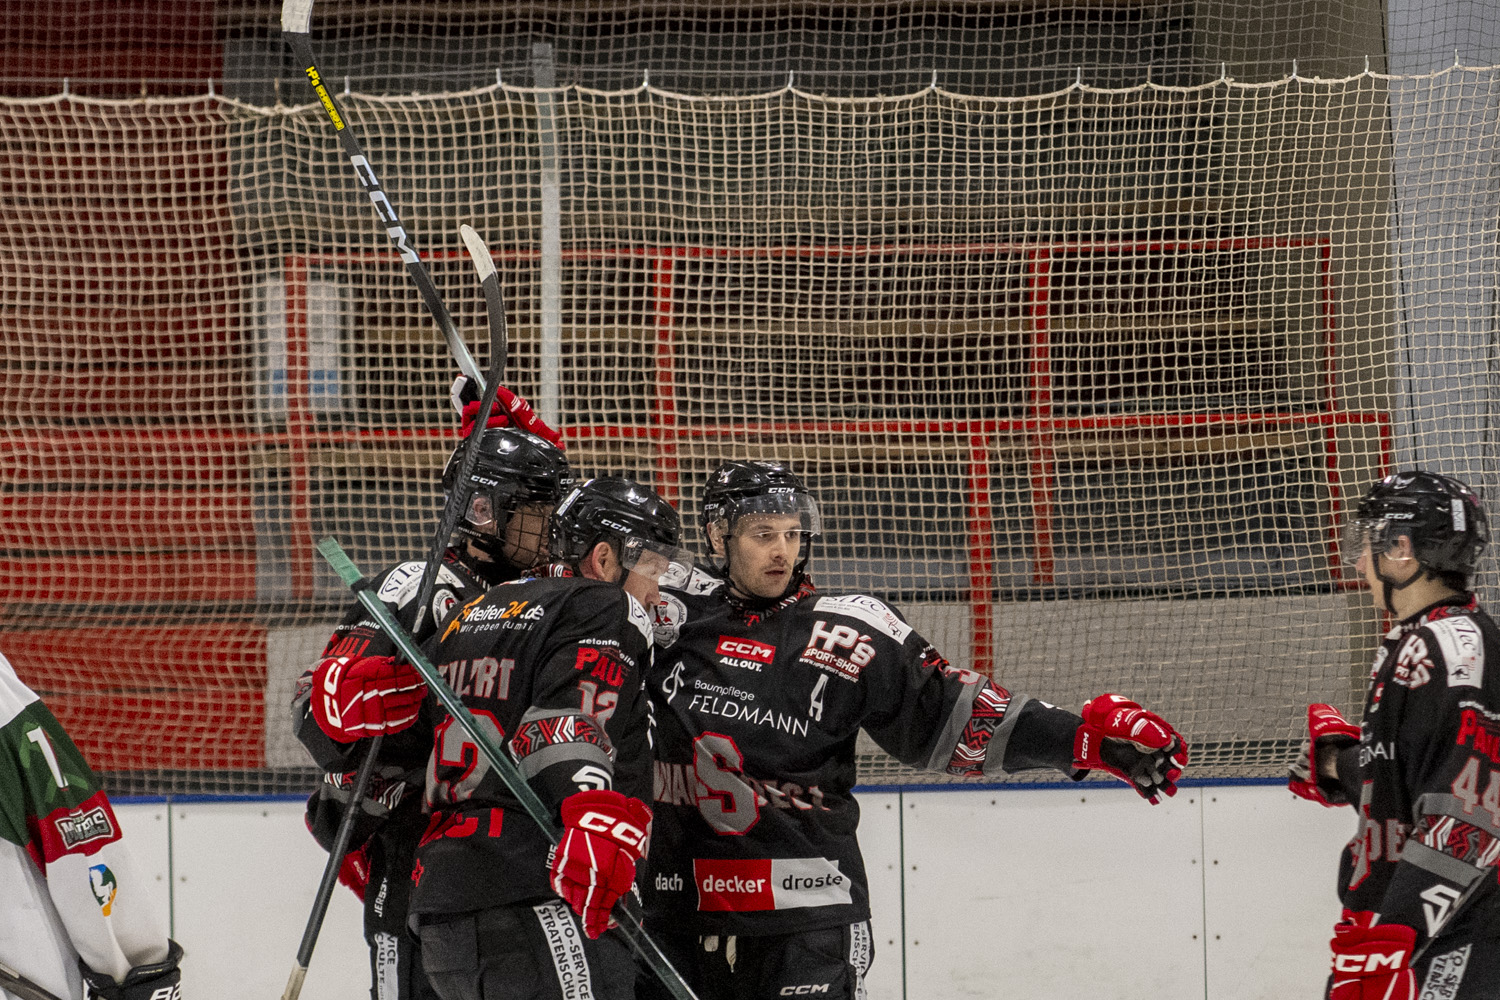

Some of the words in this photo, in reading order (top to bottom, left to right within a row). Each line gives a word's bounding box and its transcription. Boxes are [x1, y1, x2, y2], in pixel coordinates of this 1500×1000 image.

[350, 155, 419, 264] CCM
[470, 474, 499, 487] CCM
[767, 486, 795, 494] CCM
[1384, 512, 1415, 520] CCM
[600, 518, 632, 535] CCM
[465, 600, 545, 623] Reifen24.de
[719, 640, 773, 659] CCM
[694, 678, 755, 701] Baumpflege
[688, 694, 810, 738] FELDMANN
[1081, 732, 1090, 760] CCM
[655, 872, 684, 892] dach
[702, 874, 766, 894] decker
[782, 873, 844, 891] droste
[554, 900, 590, 1000] AUTO-SERVICE
[779, 984, 830, 997] CCM
